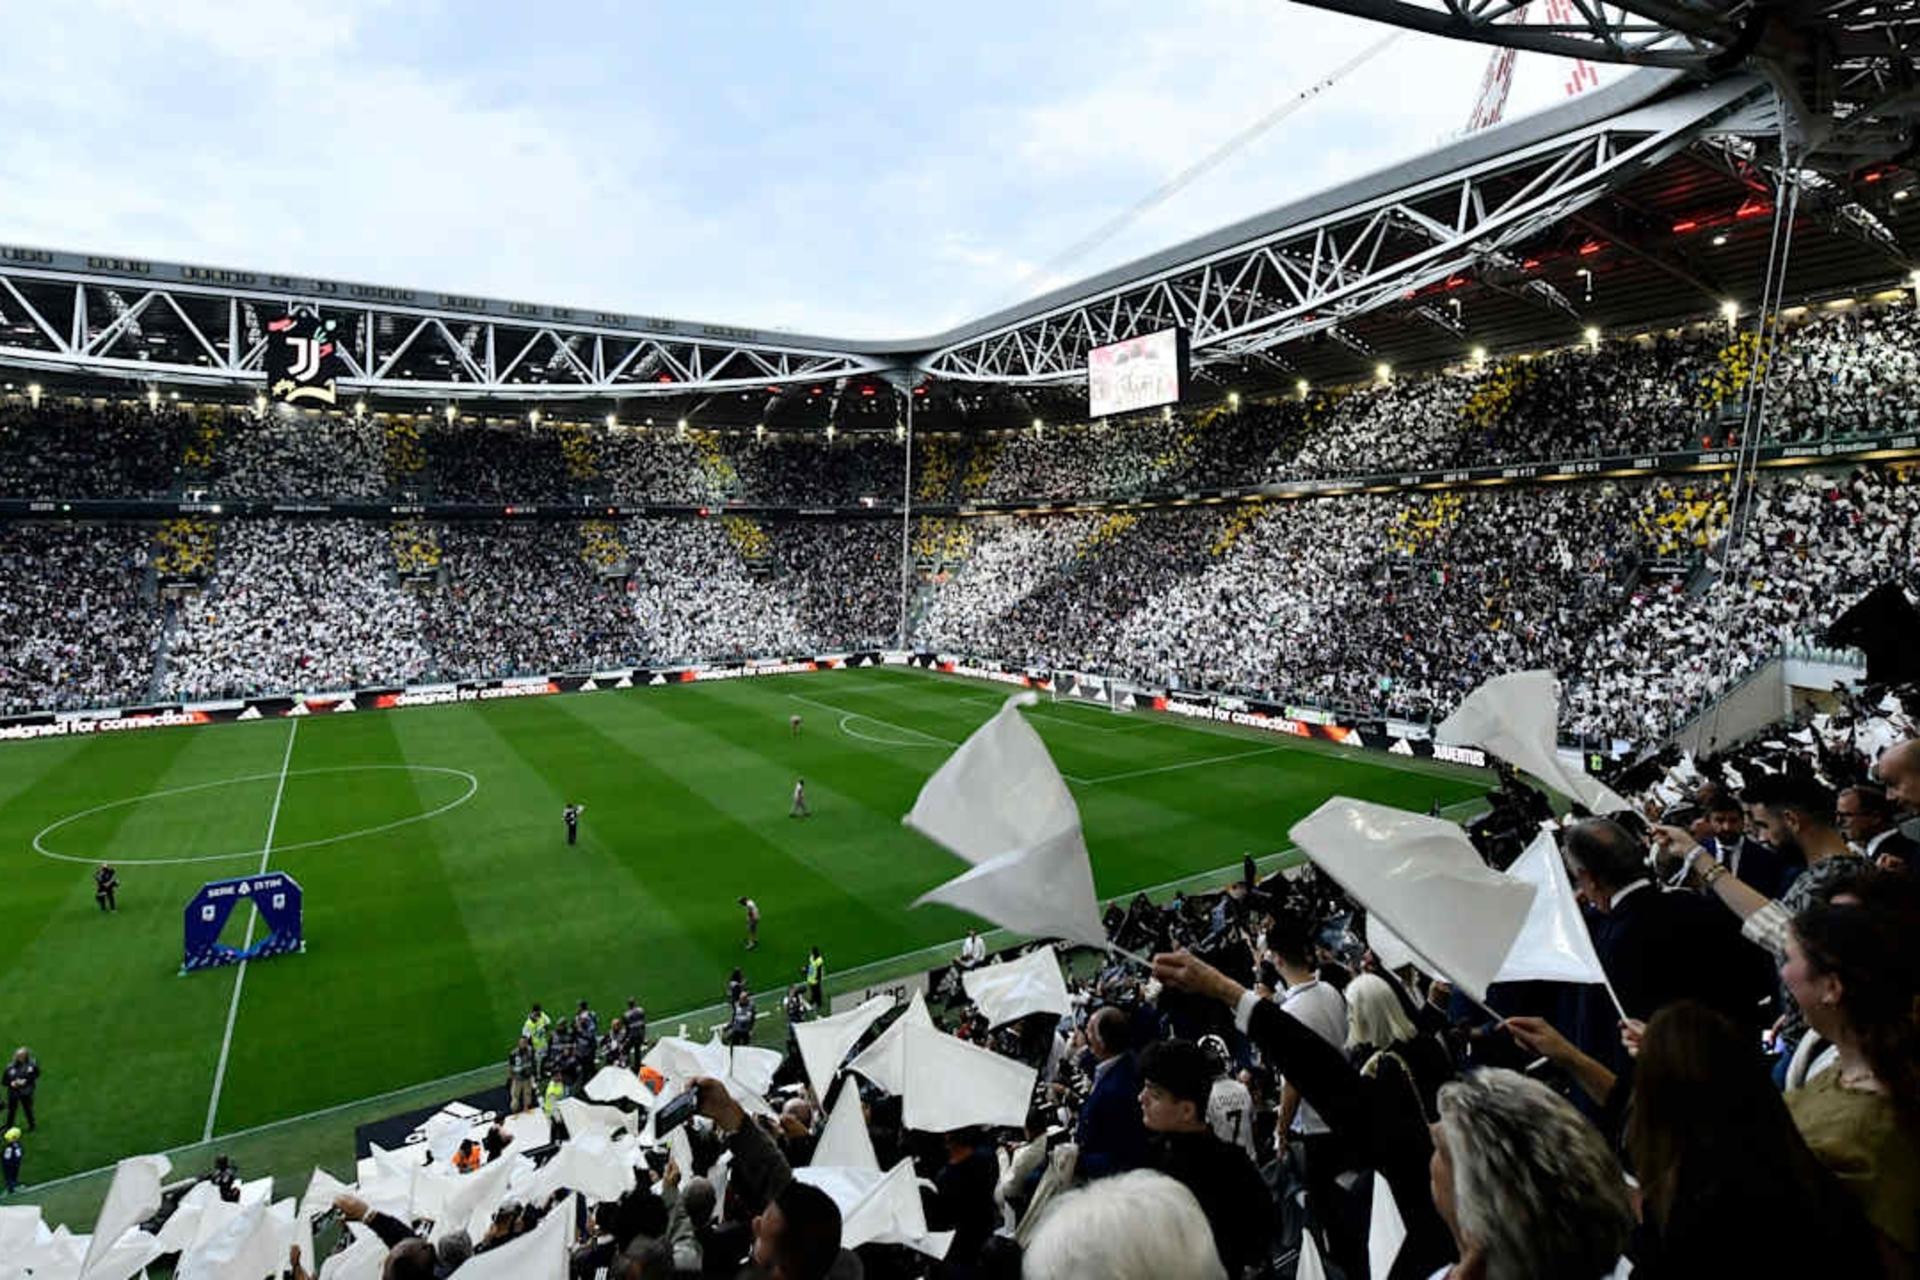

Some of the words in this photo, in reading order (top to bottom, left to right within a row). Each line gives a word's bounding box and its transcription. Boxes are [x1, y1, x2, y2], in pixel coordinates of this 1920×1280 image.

[70, 717, 98, 734] for
[99, 709, 195, 731] connection
[1214, 706, 1230, 720] for
[1226, 1109, 1242, 1143] 7
